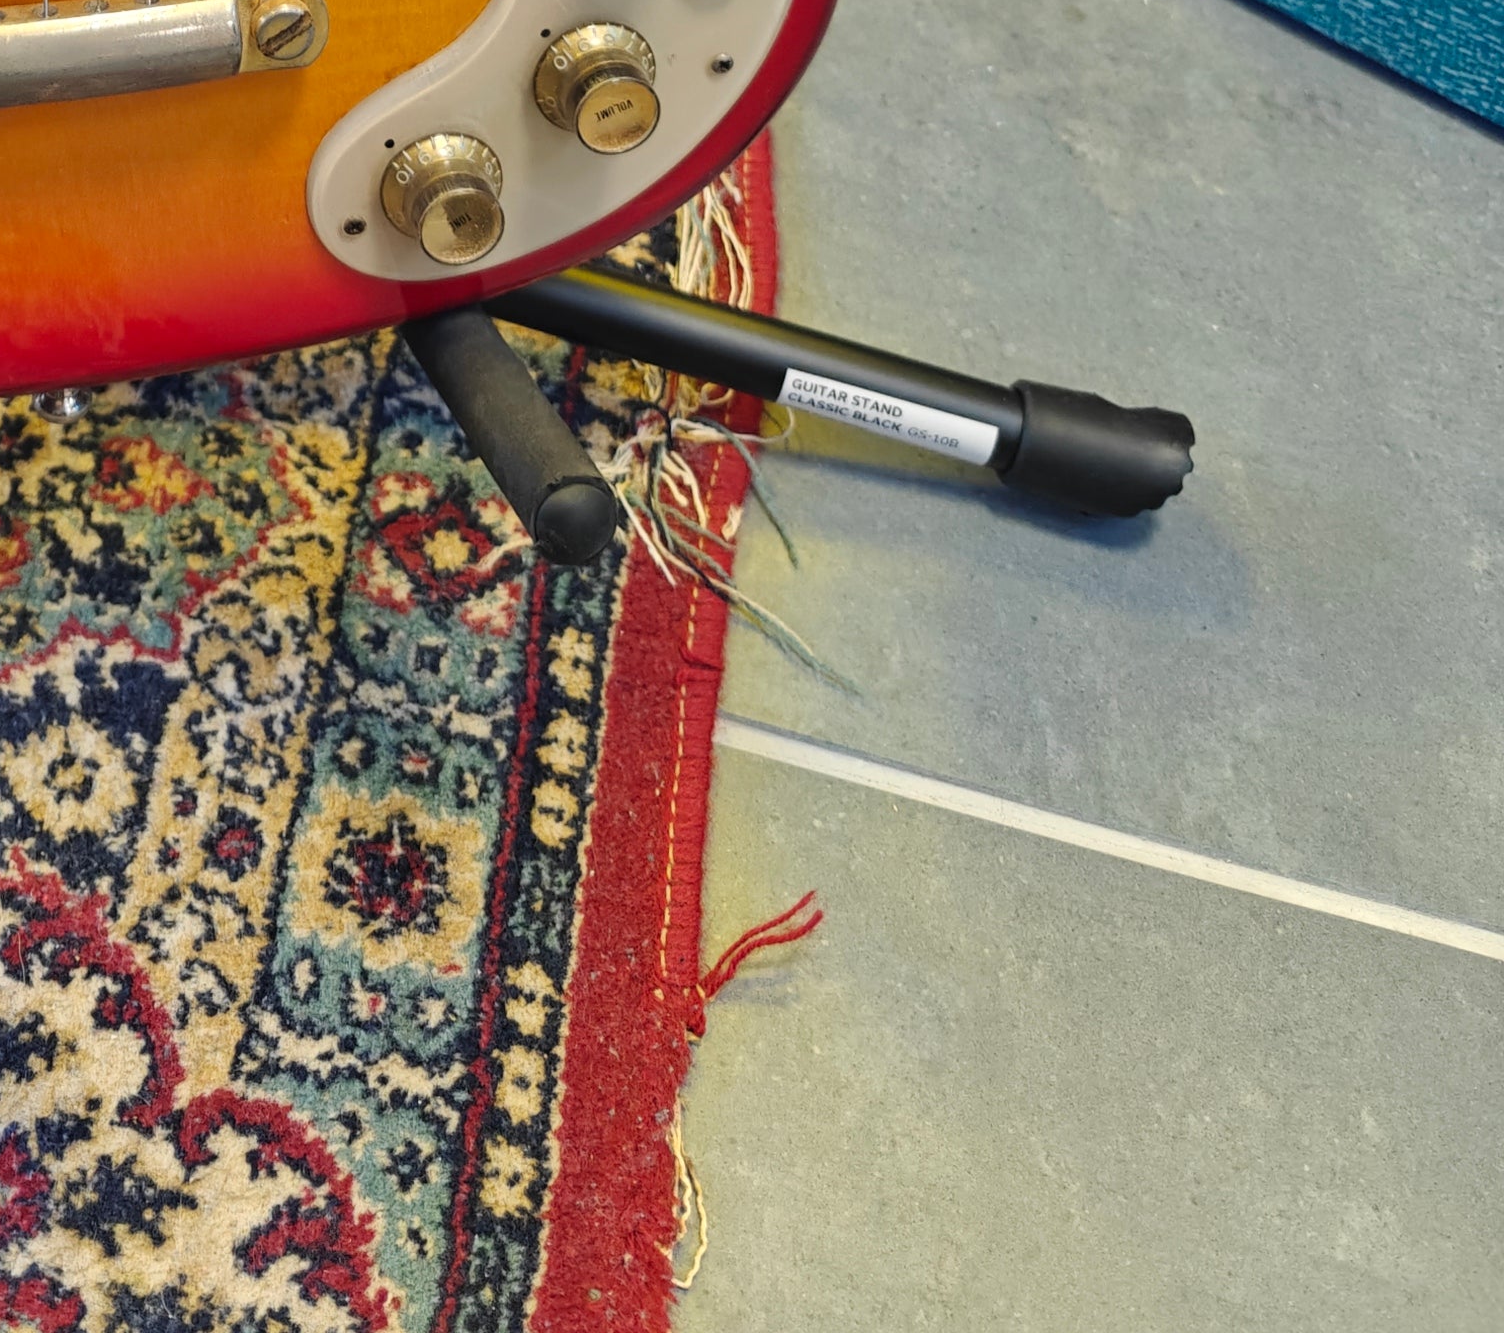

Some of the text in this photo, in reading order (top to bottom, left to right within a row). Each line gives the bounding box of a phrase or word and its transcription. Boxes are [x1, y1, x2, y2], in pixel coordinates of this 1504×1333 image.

[553, 48, 573, 70] 10
[594, 99, 634, 122] VOLUME
[396, 163, 415, 184] 10
[449, 213, 472, 232] TONE
[792, 378, 903, 418] GUITAR STAND
[788, 392, 848, 416] CLASSIC
[853, 410, 902, 432] BLACK
